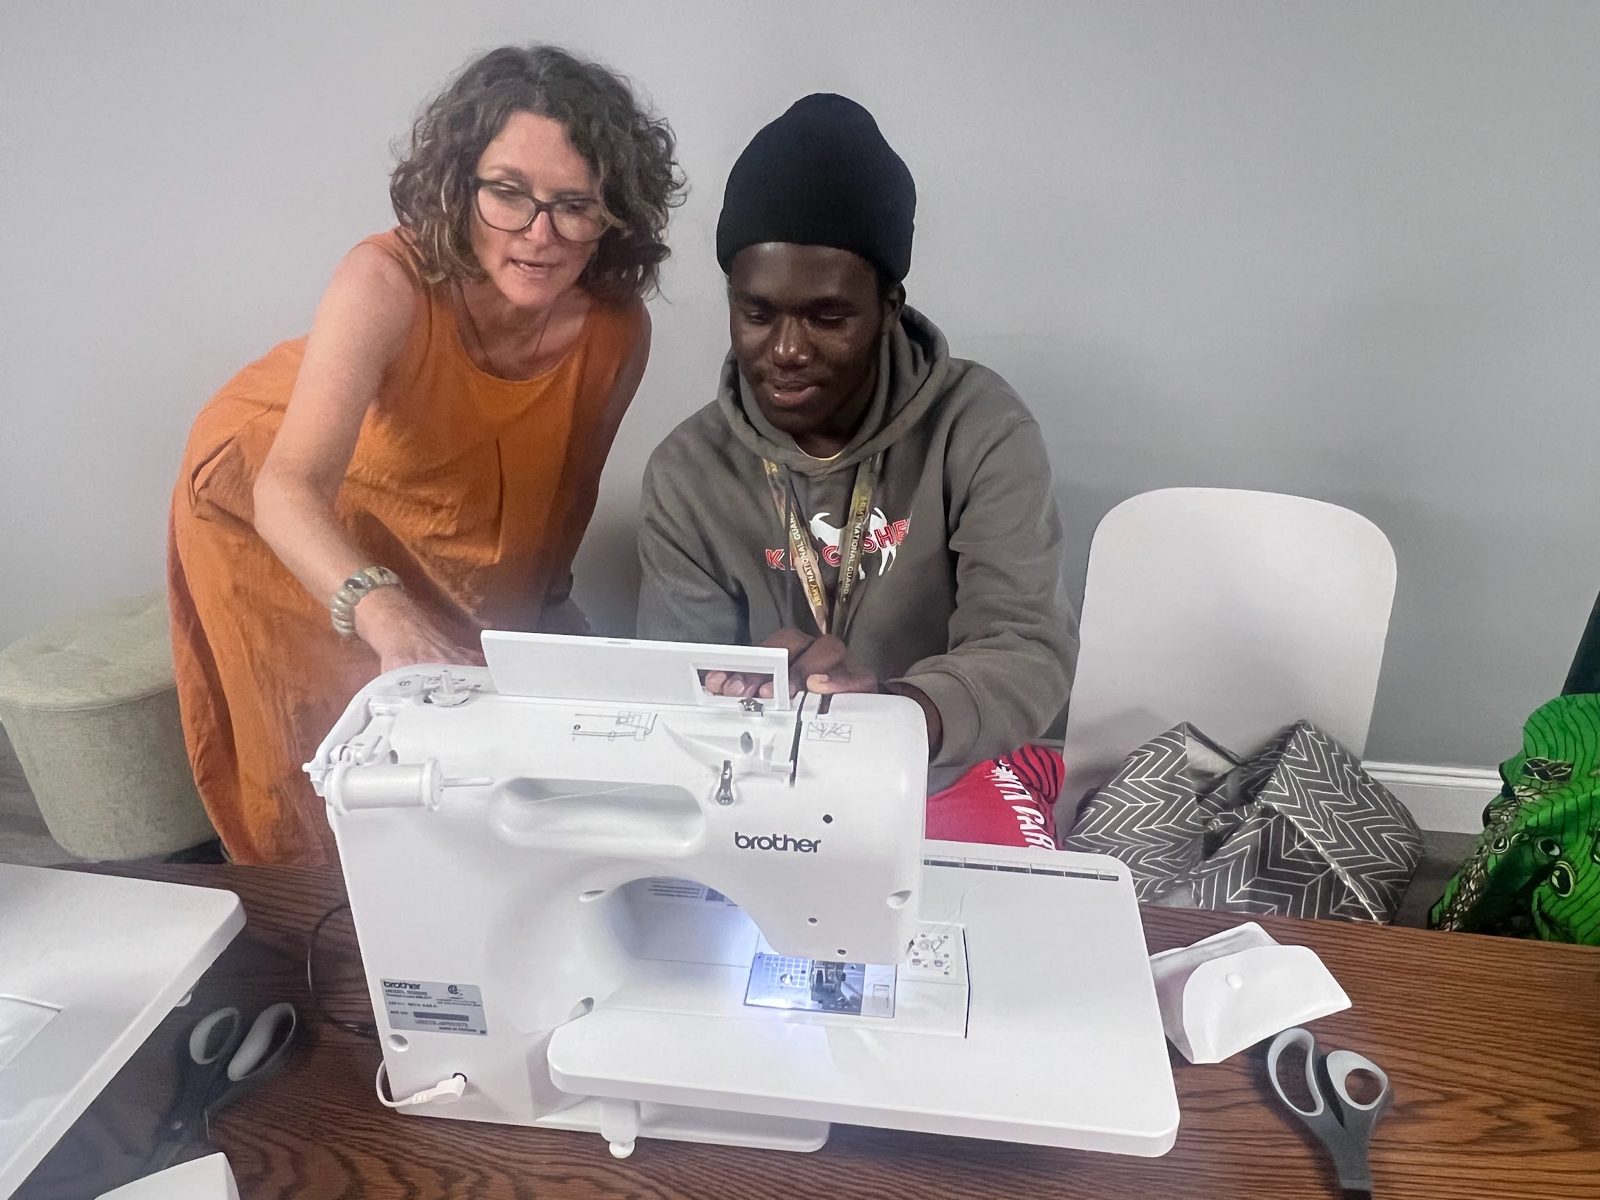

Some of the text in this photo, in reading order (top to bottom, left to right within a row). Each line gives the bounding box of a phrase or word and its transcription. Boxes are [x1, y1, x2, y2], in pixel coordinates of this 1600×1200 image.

[848, 522, 861, 566] NATIONAL
[796, 542, 815, 583] NATIONAL
[842, 566, 853, 594] GUARD
[809, 582, 823, 607] ARMY
[735, 832, 821, 854] brother
[383, 980, 421, 990] brother
